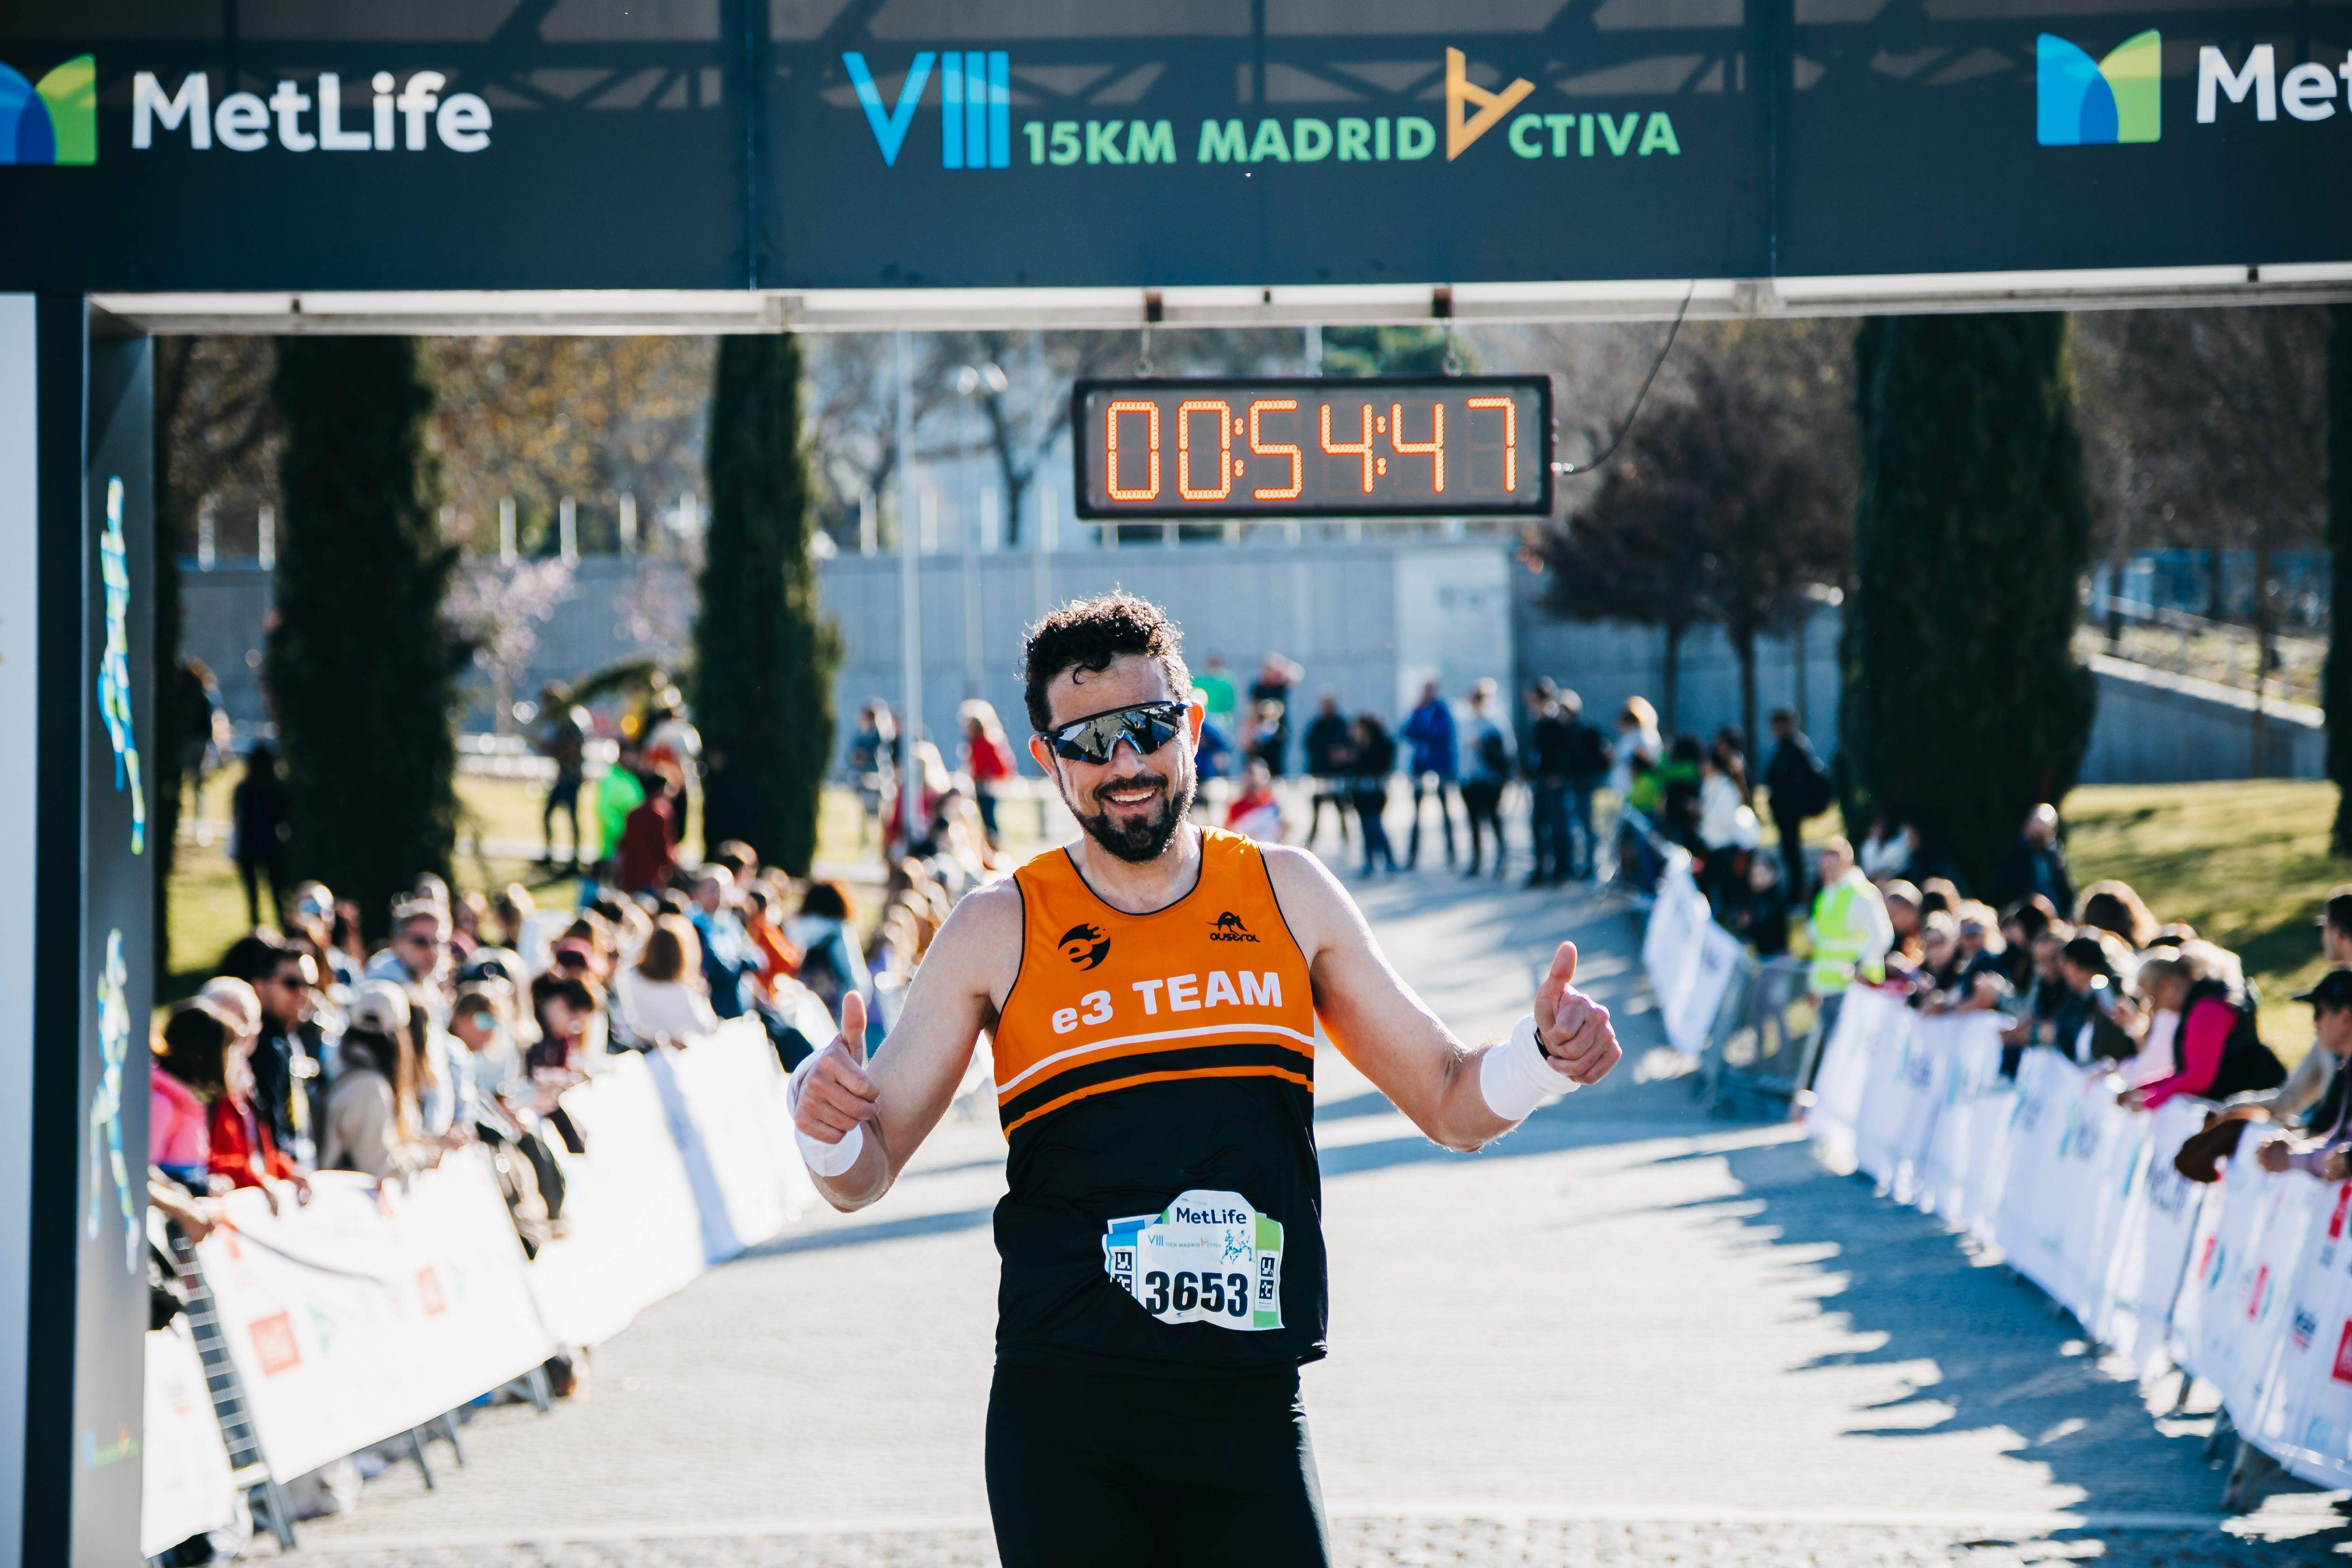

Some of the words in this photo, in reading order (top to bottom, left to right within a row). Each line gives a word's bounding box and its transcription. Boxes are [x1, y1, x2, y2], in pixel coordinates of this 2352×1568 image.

[133, 71, 493, 153] MetLife
[841, 50, 1010, 169] VIII
[1023, 120, 1177, 166] 15KM
[1197, 116, 1436, 163] MADRID
[2197, 43, 2352, 124] Me
[1106, 397, 1516, 500] 00:54:47
[1209, 932, 1261, 943] austral
[1052, 990, 1113, 1034] e3
[1132, 971, 1282, 1015] TEAM
[1148, 1234, 1164, 1246] VIII
[1176, 1207, 1247, 1225] MetLife
[1145, 1271, 1248, 1317] 3653
